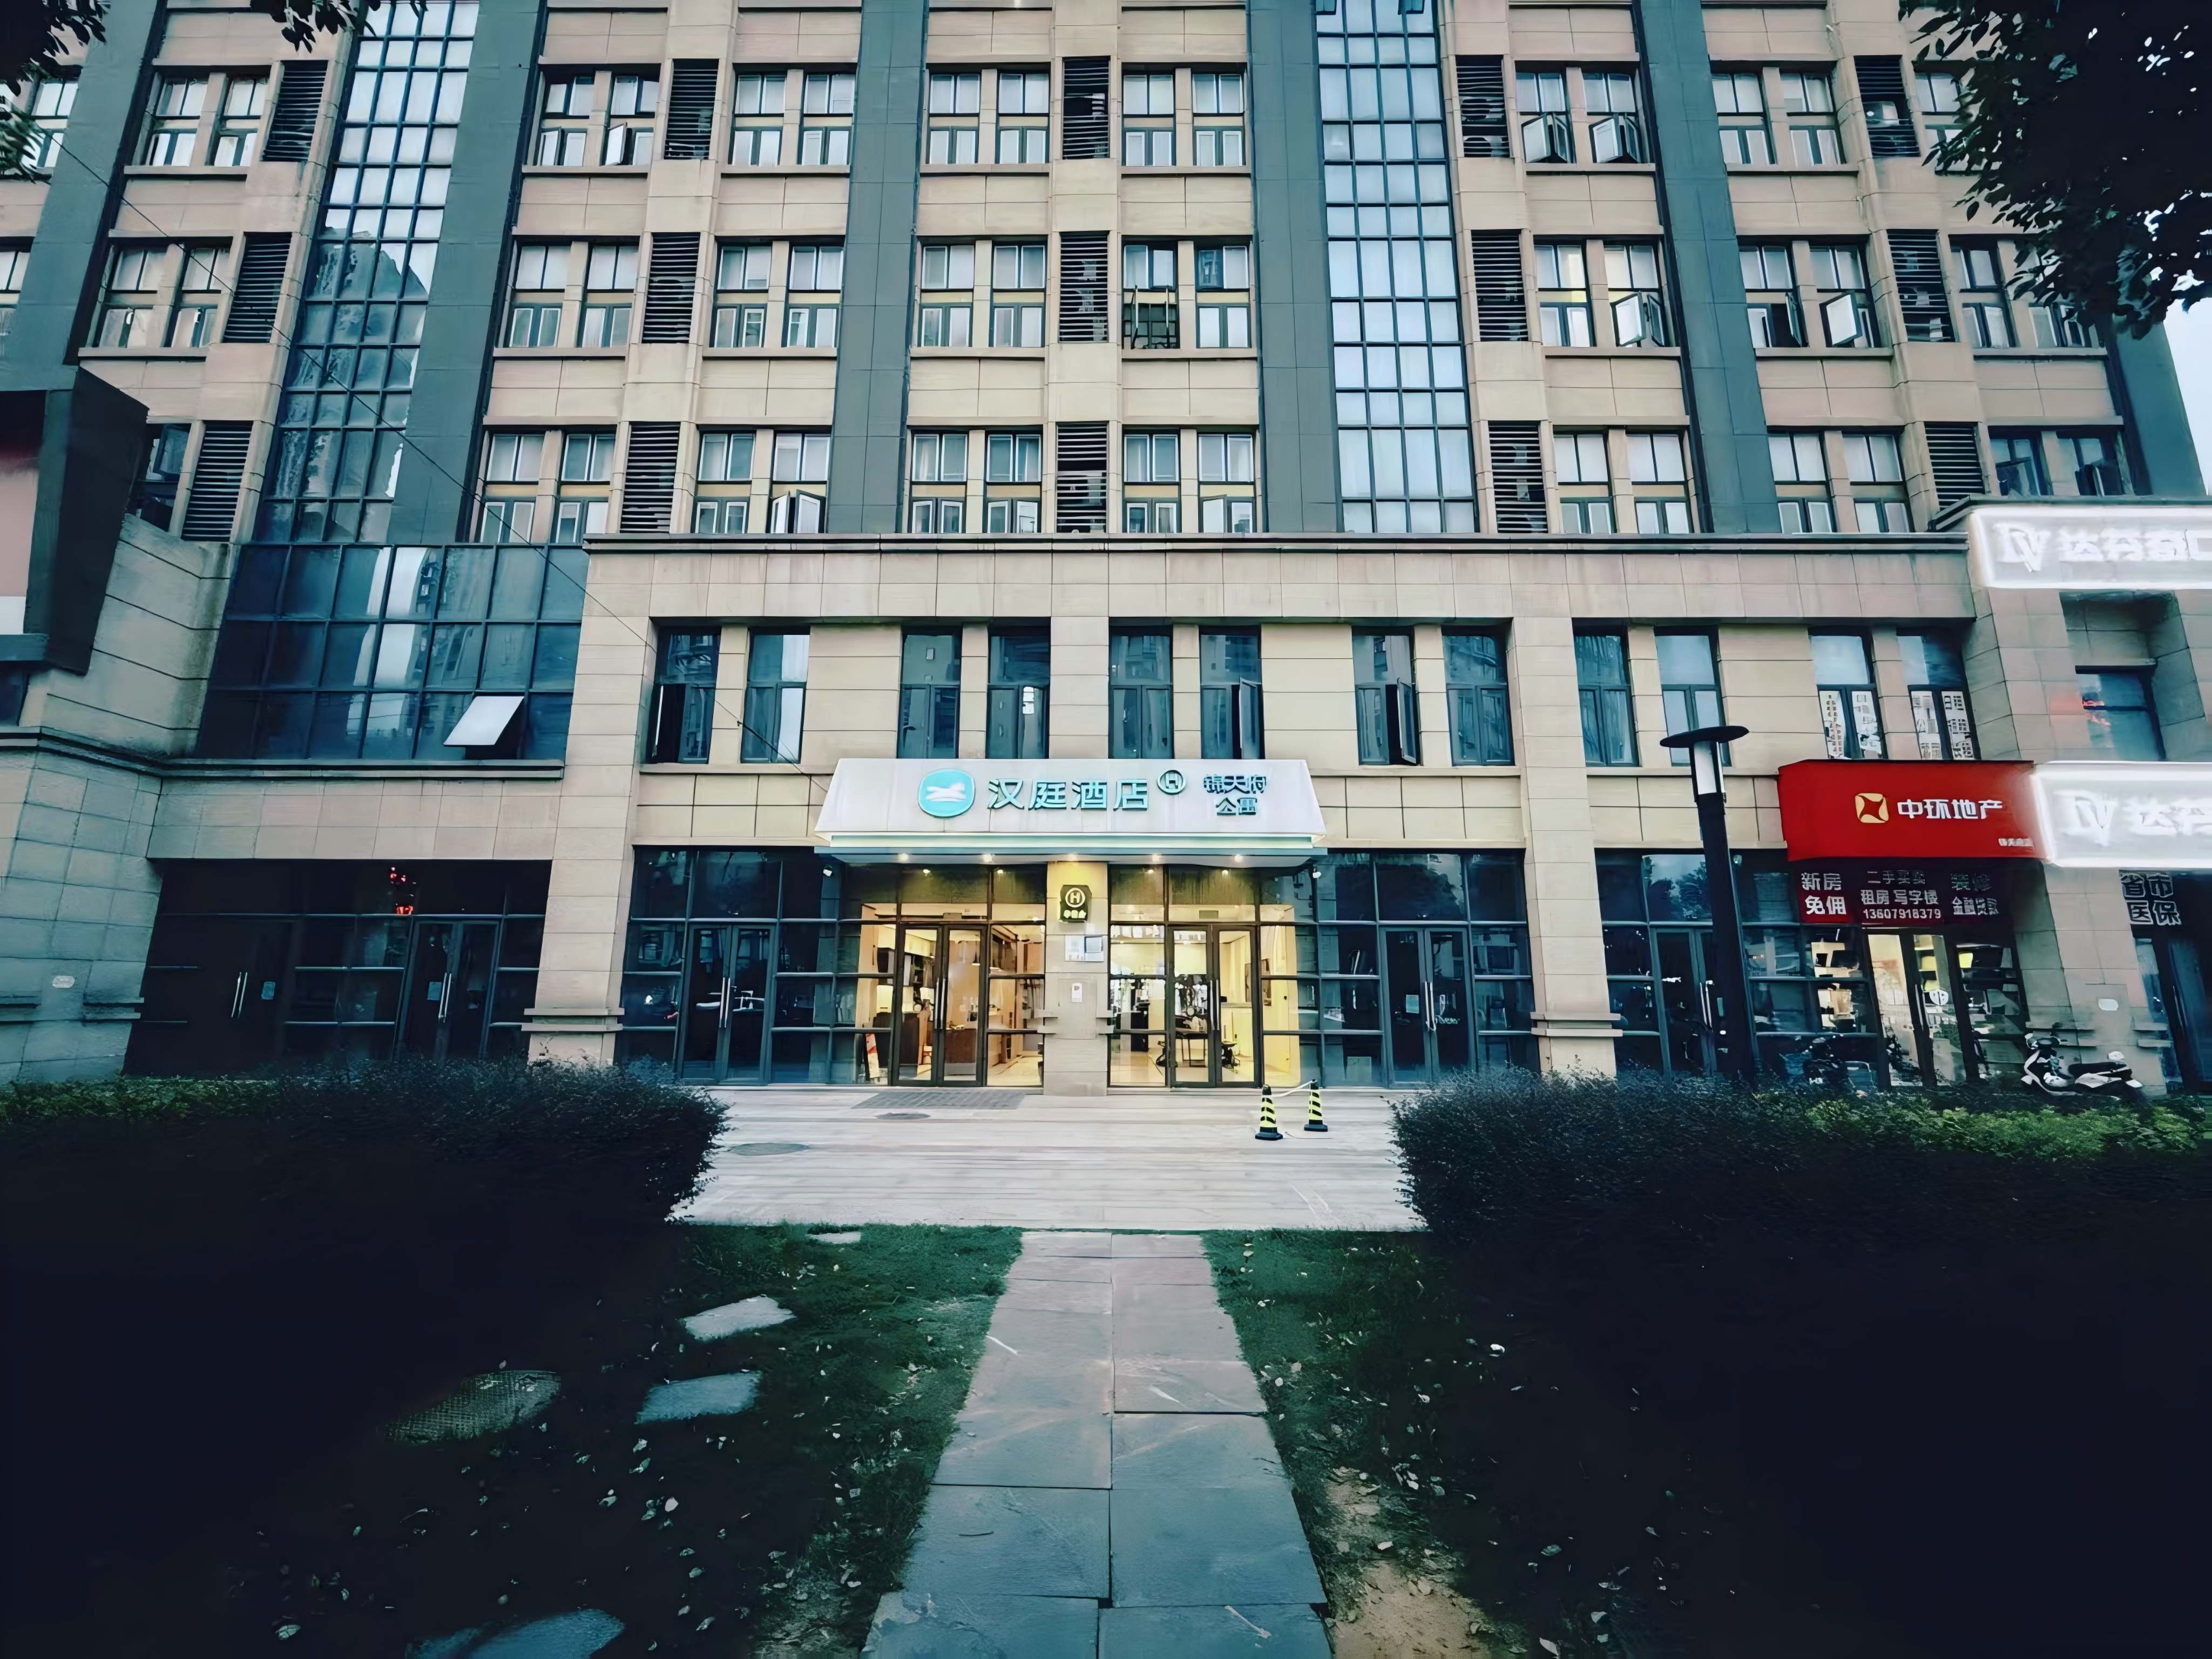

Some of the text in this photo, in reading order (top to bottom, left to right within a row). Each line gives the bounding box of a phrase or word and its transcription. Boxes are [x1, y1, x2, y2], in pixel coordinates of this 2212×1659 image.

[987, 778, 1148, 810] 汉庭酒店
[1897, 799, 2003, 819] 中环地产
[1801, 872, 1842, 891] 新房
[2120, 872, 2173, 898] 省市
[1805, 895, 1847, 915] 免佣
[2126, 899, 2181, 926] 医保
